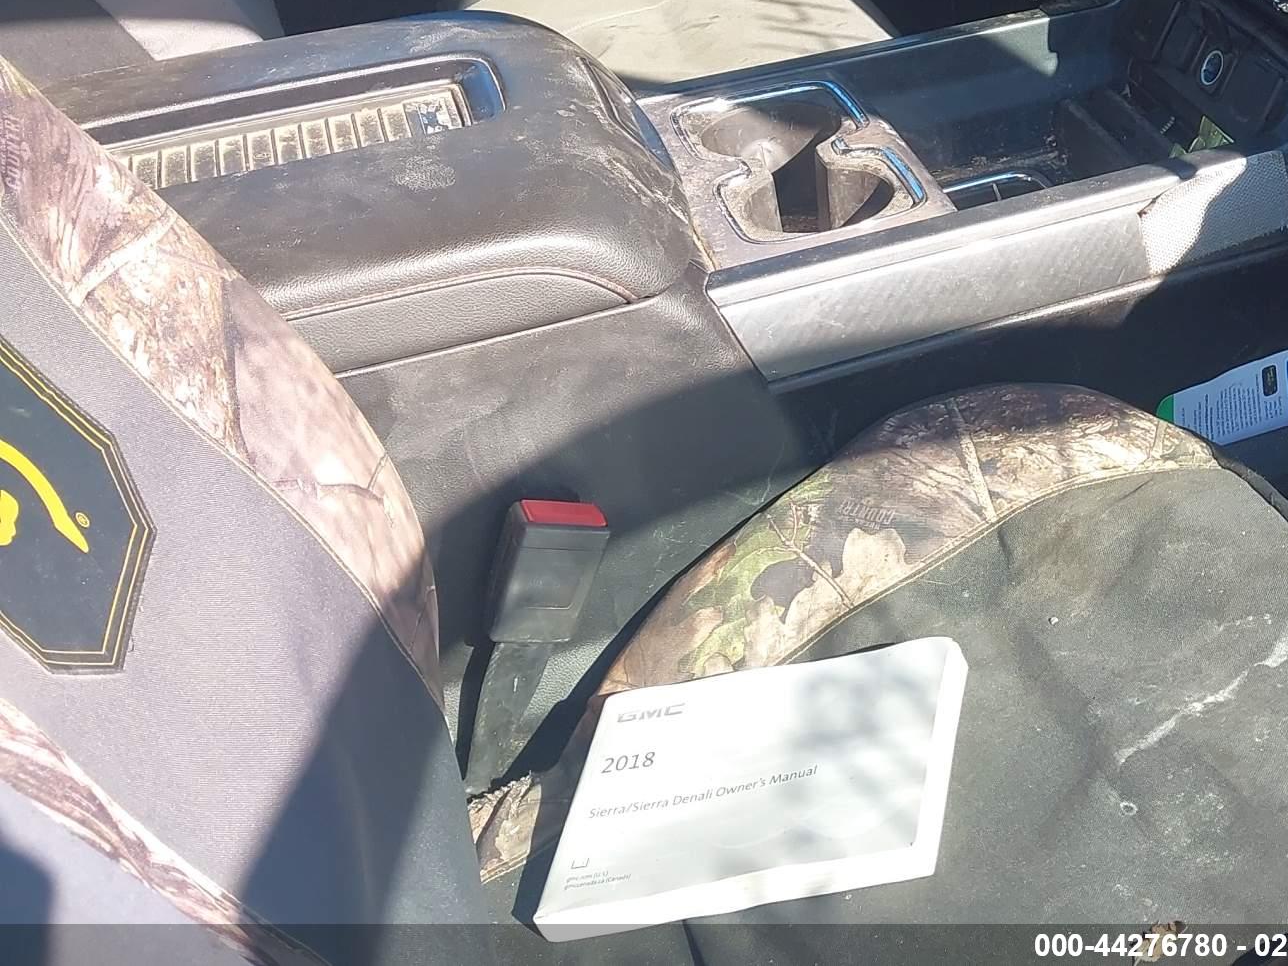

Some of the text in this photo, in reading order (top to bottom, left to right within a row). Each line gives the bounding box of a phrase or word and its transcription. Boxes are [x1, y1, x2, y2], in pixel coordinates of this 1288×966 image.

[616, 703, 686, 723] GMC
[601, 751, 656, 774] 2018
[588, 764, 818, 819] Sierra/Sierra Denali Owner's Manual
